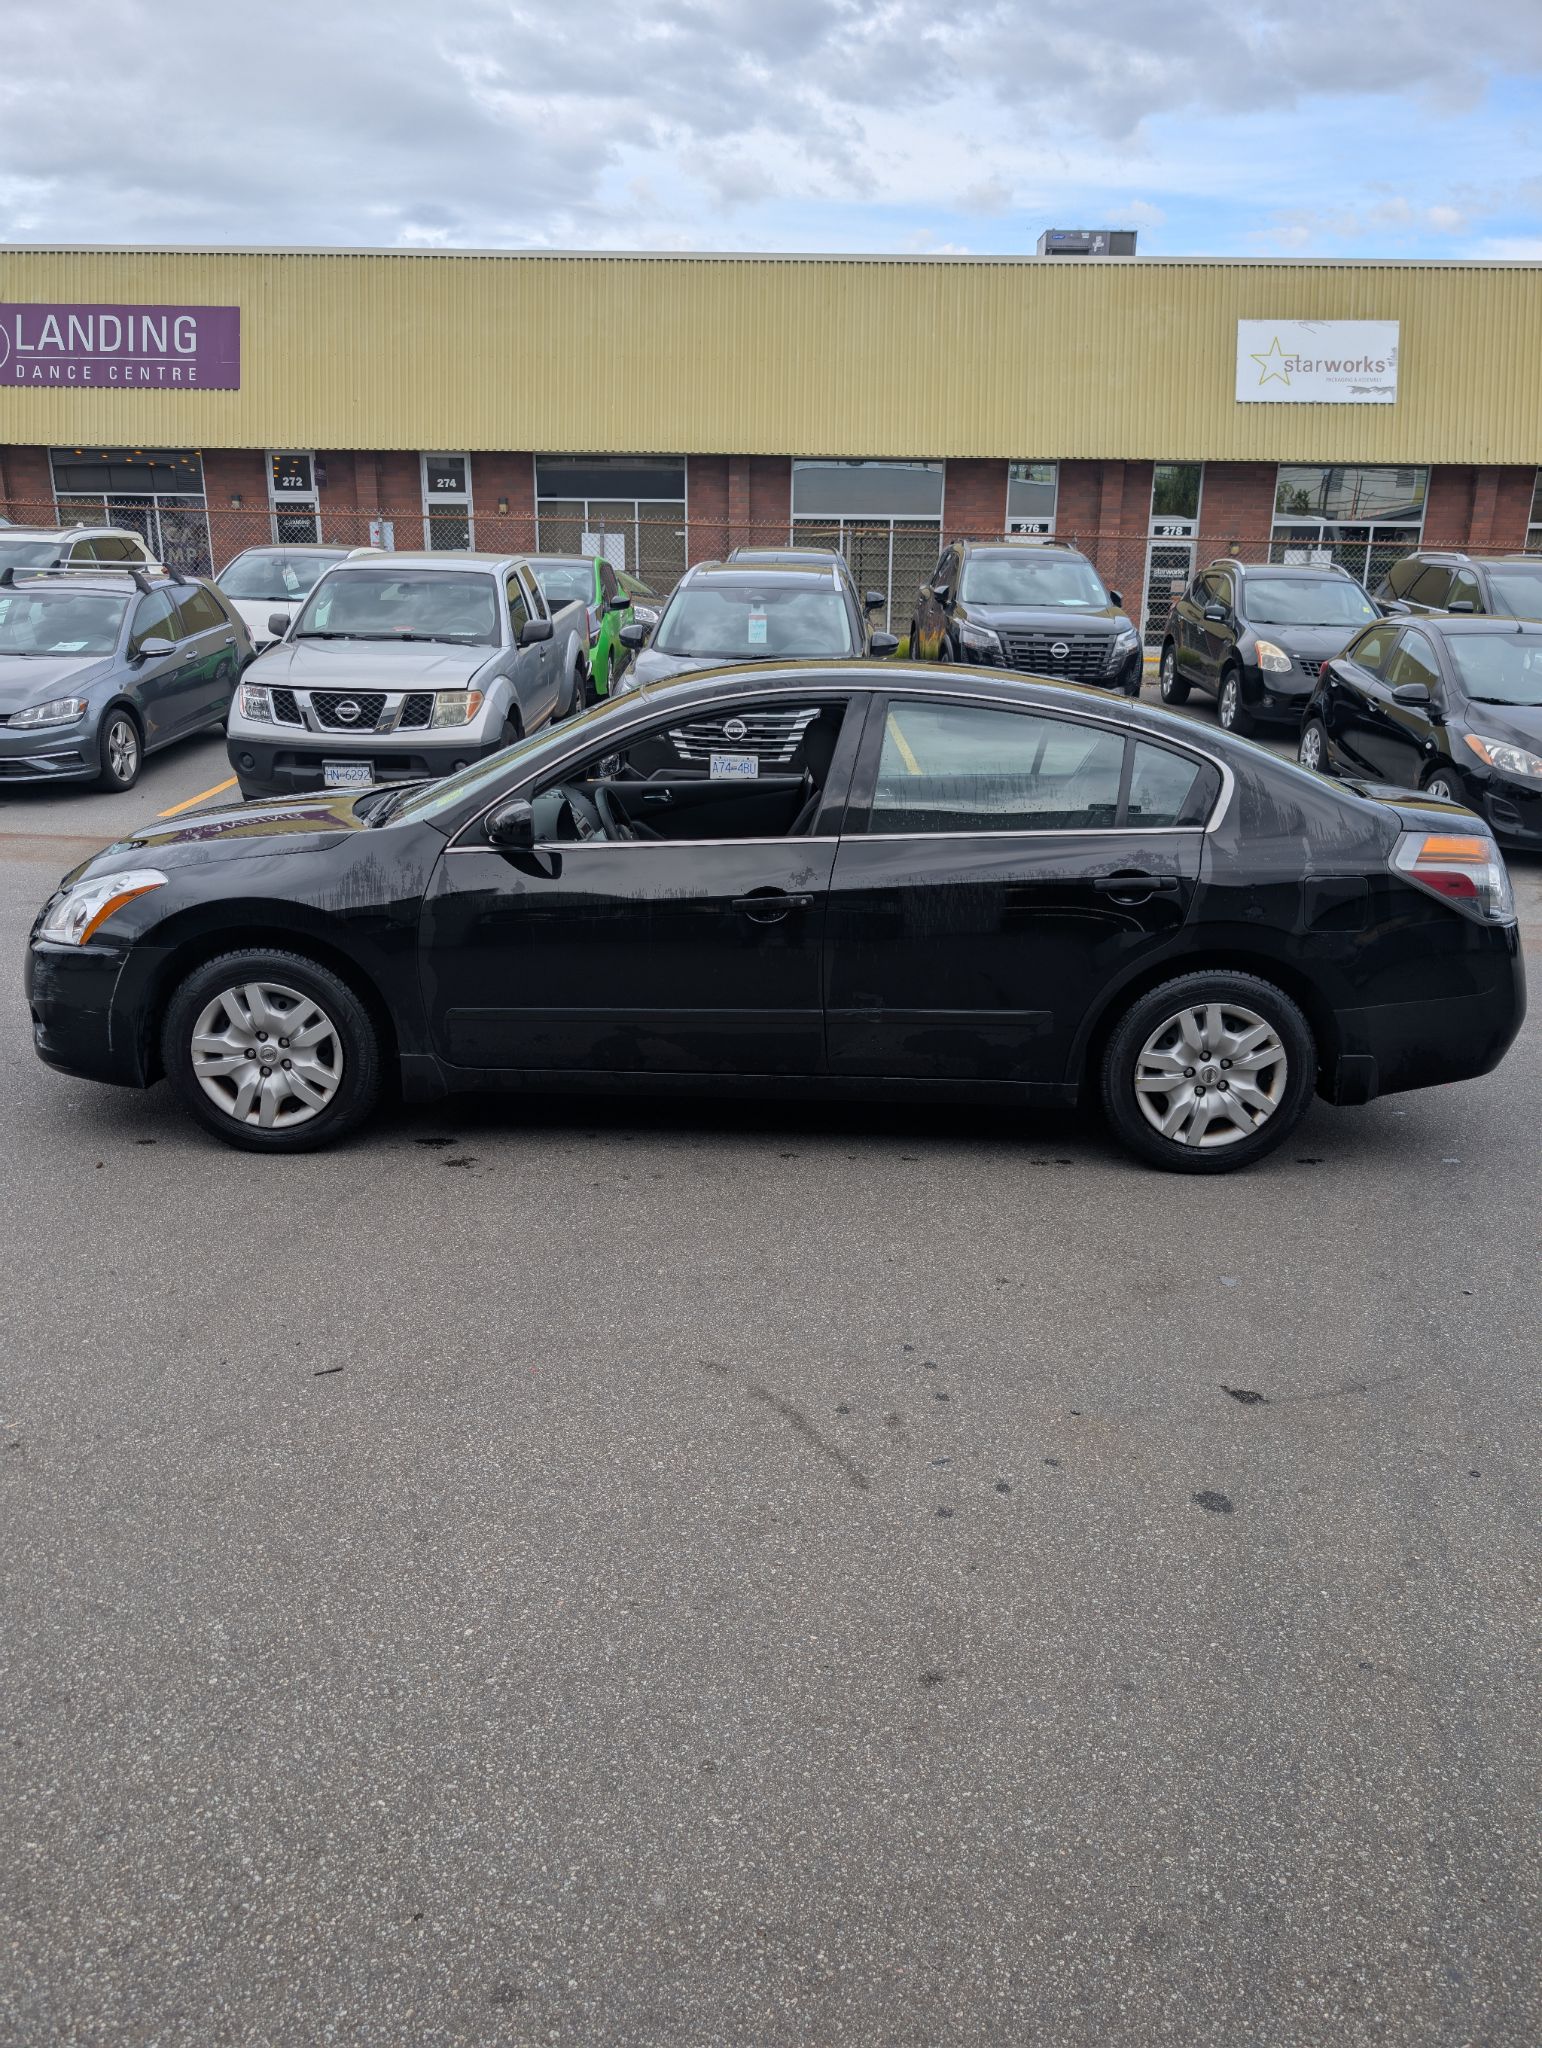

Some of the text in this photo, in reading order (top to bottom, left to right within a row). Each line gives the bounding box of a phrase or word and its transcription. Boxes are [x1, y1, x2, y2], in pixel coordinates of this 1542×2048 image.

[15, 314, 198, 353] LANDING
[1284, 354, 1385, 373] starworks
[16, 364, 198, 382] DANCE CENTRE
[282, 477, 303, 487] 272
[436, 477, 457, 489] 274
[1020, 524, 1040, 533] 276
[1162, 526, 1183, 536] 278
